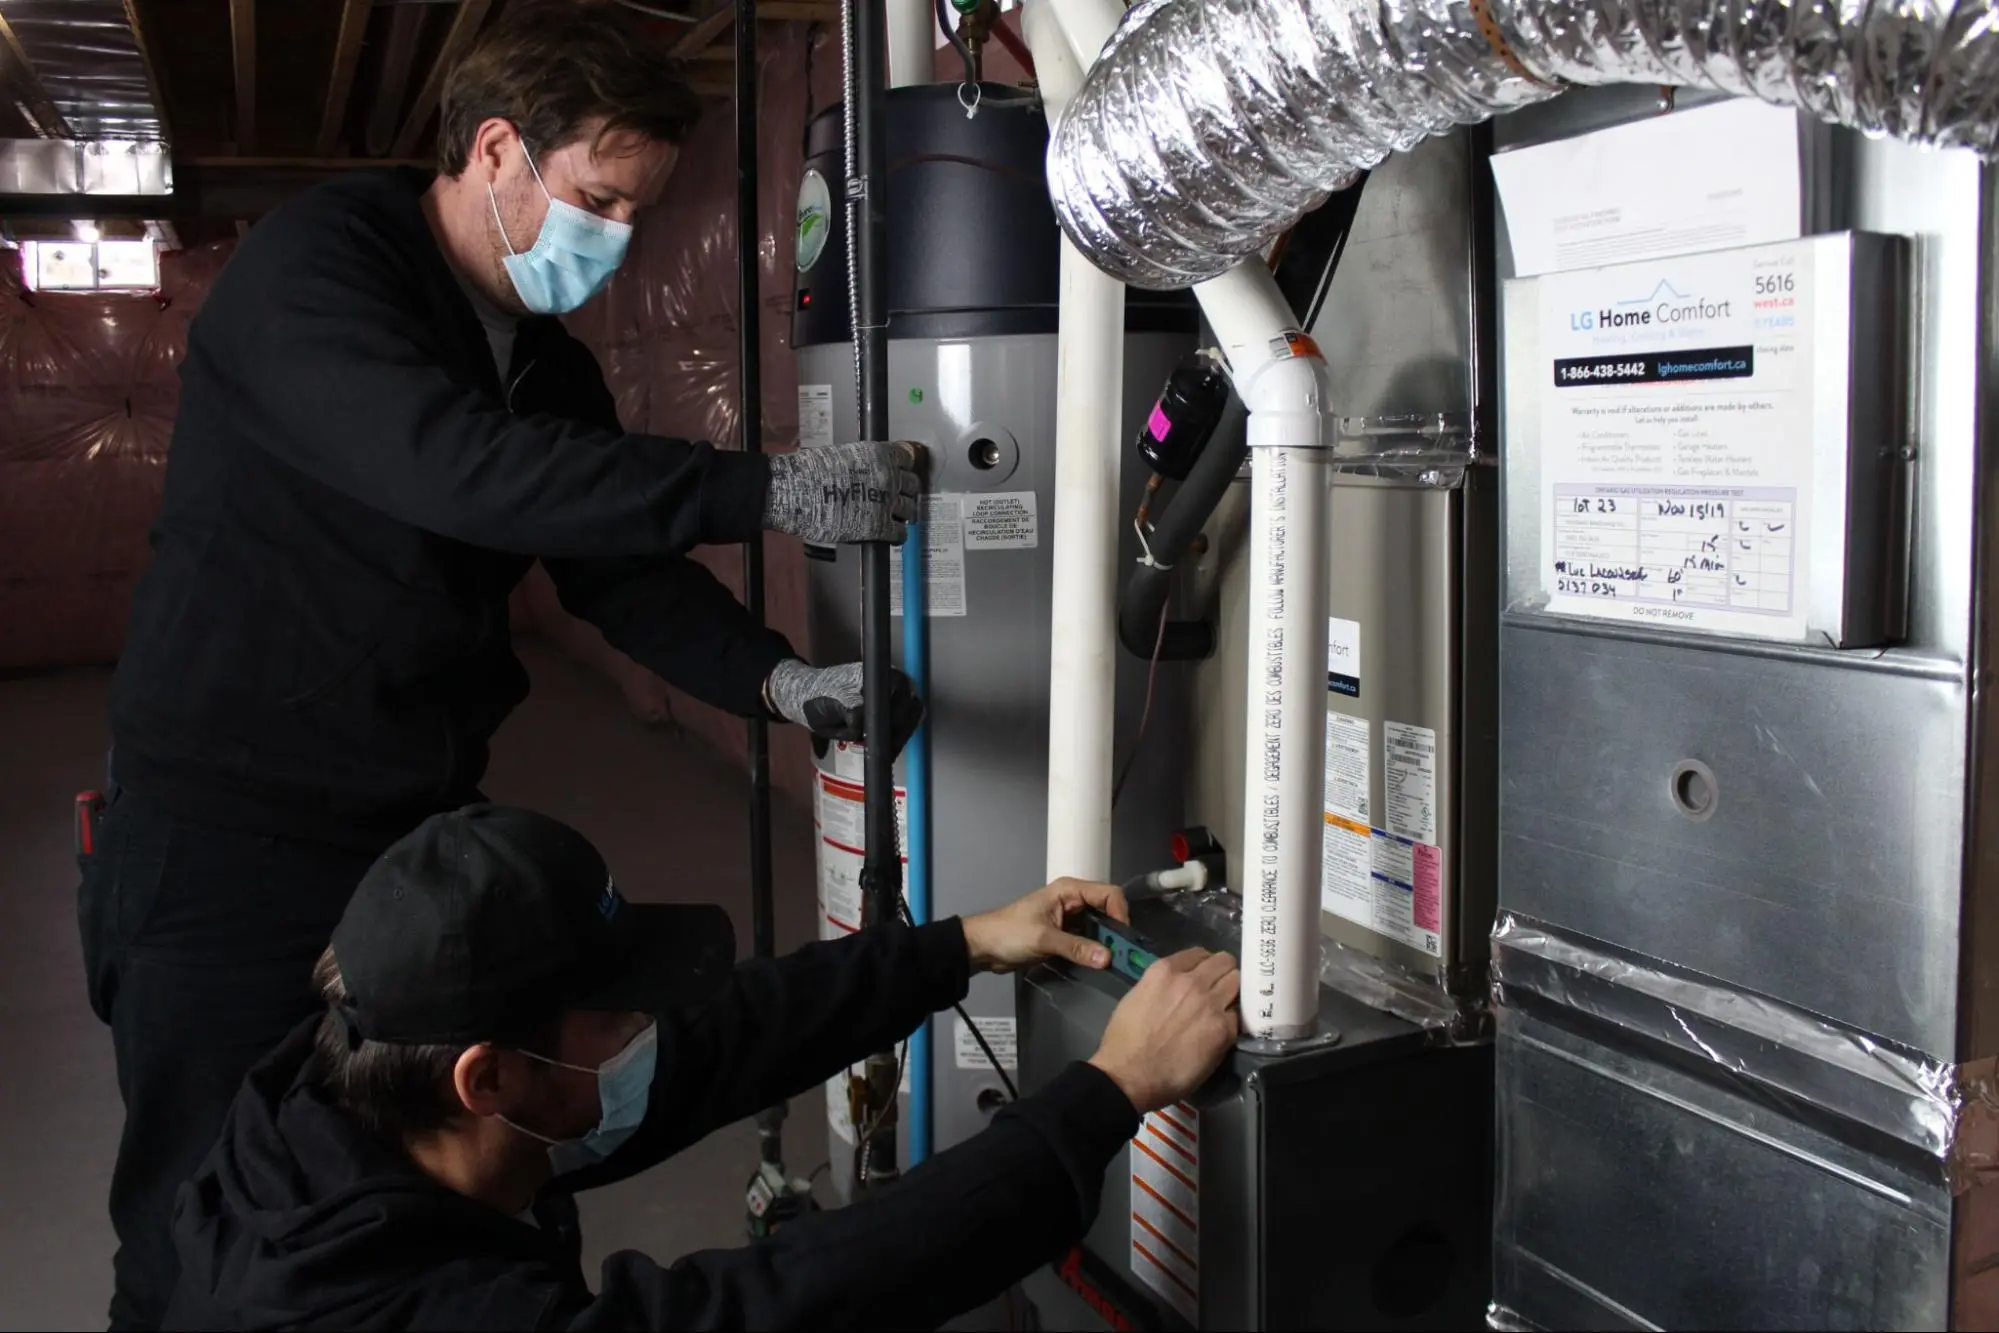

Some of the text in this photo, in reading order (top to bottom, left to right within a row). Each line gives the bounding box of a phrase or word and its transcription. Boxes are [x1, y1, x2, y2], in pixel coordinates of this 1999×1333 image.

[1755, 273, 1795, 295] 5616
[1571, 297, 1731, 331] LG Home Comfort
[1561, 359, 1747, 380] 1-866-438-5442 lghomecomfort.ca
[1717, 403, 1736, 411] made
[1738, 402, 1747, 413] by
[823, 482, 890, 506] HyFlex
[1598, 498, 1616, 513] 23
[1267, 588, 1286, 620] FOLLOW
[1632, 607, 1695, 620] DO NOT REMOVE
[1265, 627, 1285, 687] COMBUSTIBLES
[1265, 690, 1283, 706] DES
[1264, 709, 1283, 729] ZERO
[1263, 732, 1282, 782] DEGAGEMENT
[1262, 794, 1281, 853] COMBUSTIBLES
[1261, 855, 1279, 865] TO
[1260, 868, 1279, 913] CLEARANCE
[1260, 915, 1278, 935] ZERO
